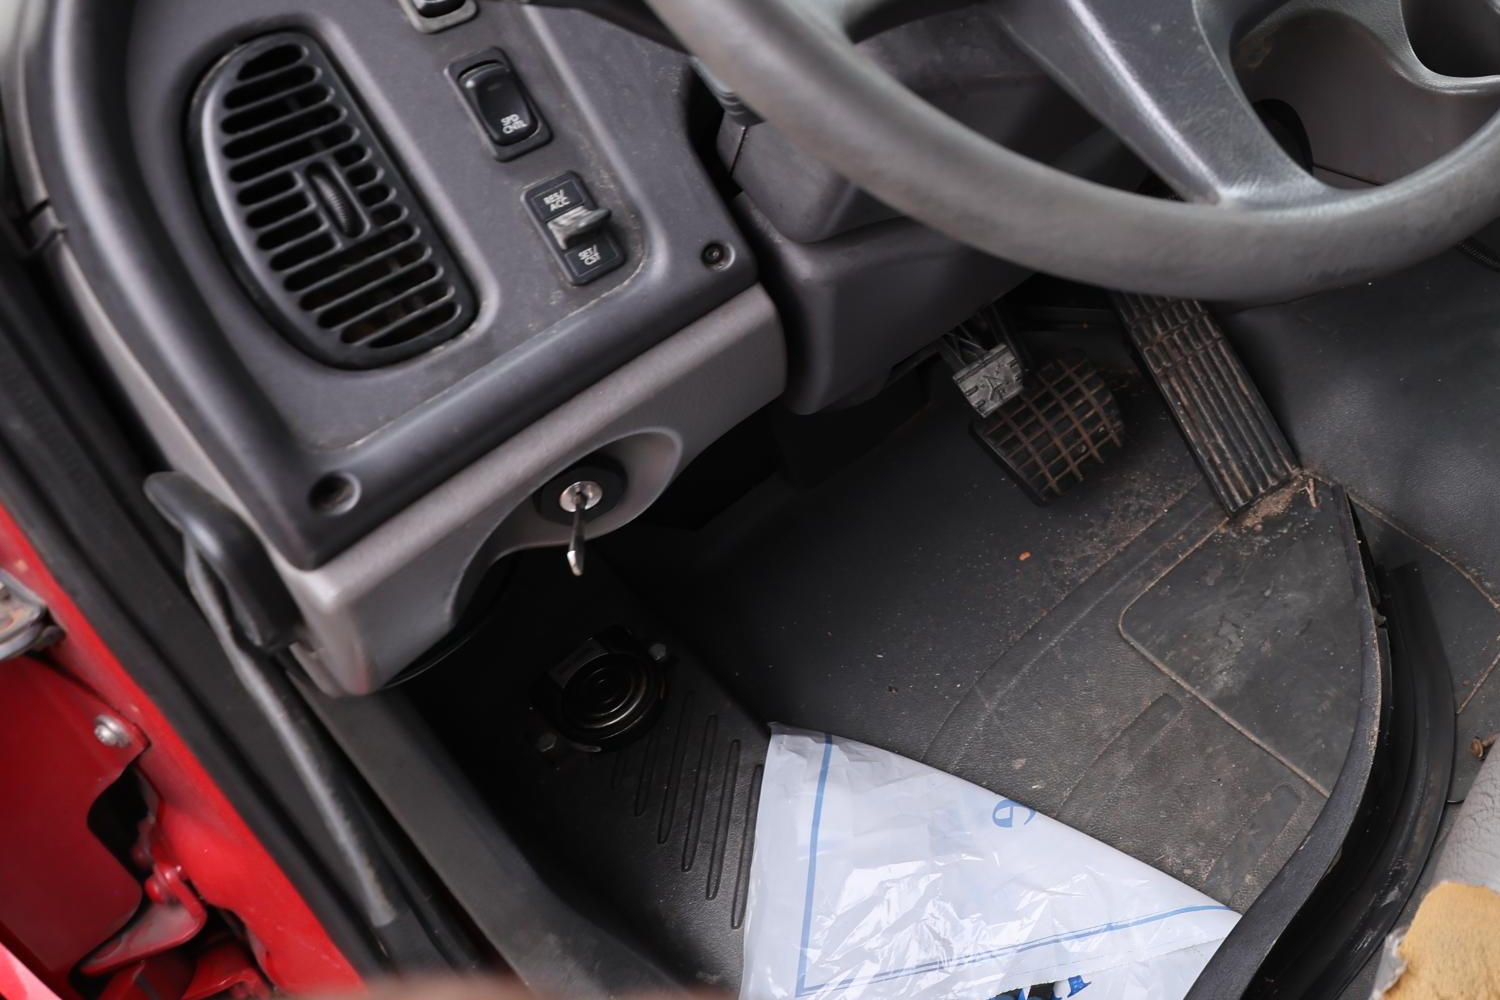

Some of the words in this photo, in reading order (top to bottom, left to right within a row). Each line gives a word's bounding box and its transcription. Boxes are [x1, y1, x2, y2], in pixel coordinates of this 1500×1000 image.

[501, 114, 519, 125] SPD
[550, 198, 570, 211] ACC
[578, 245, 597, 259] SET/
